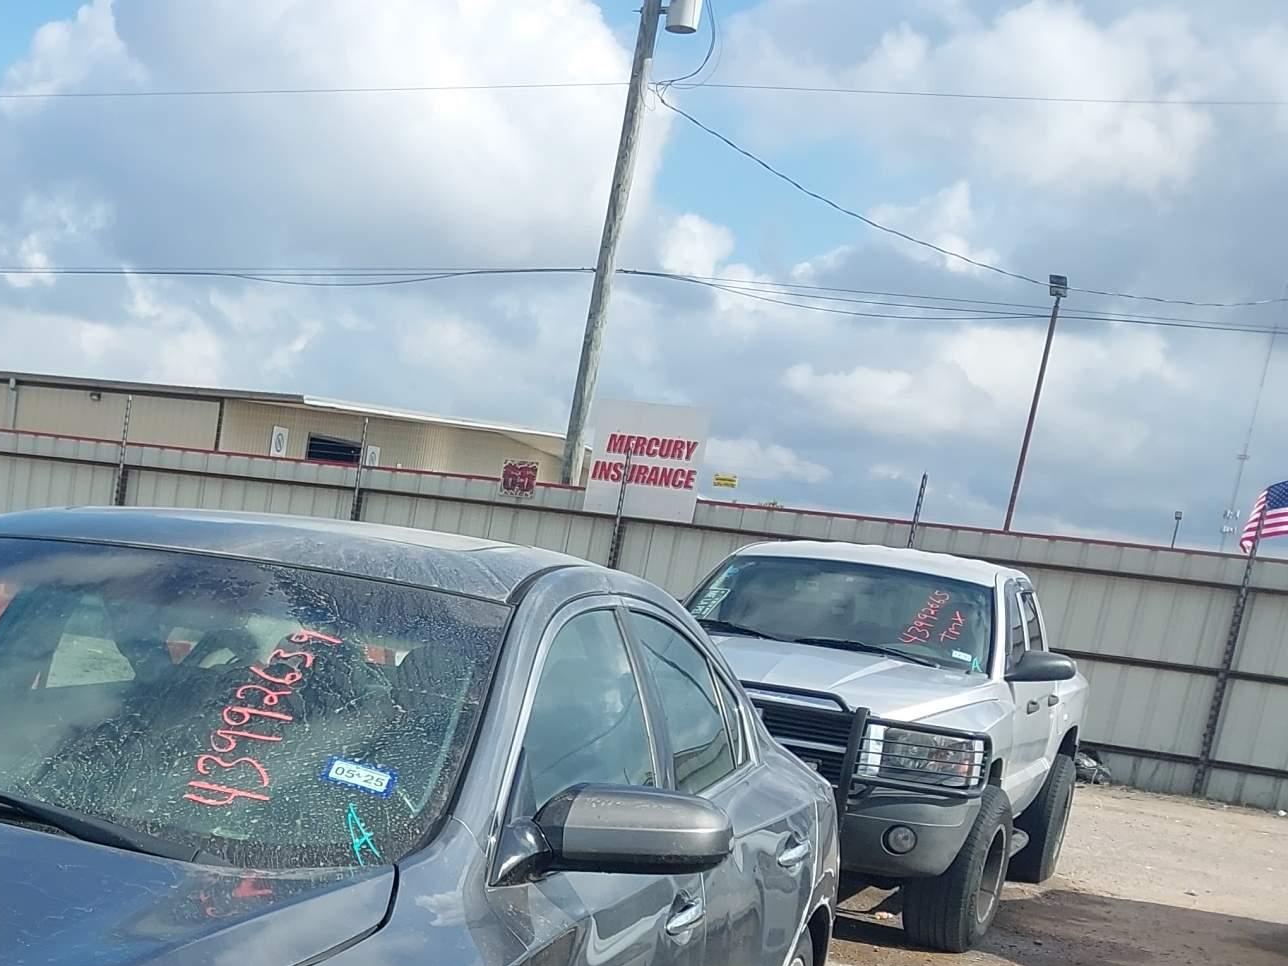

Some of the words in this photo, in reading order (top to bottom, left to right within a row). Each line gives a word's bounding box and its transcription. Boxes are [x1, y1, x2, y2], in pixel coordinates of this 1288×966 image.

[606, 433, 699, 462] MERCURY
[591, 460, 698, 490] INSURANCE
[183, 628, 344, 806] 43992639
